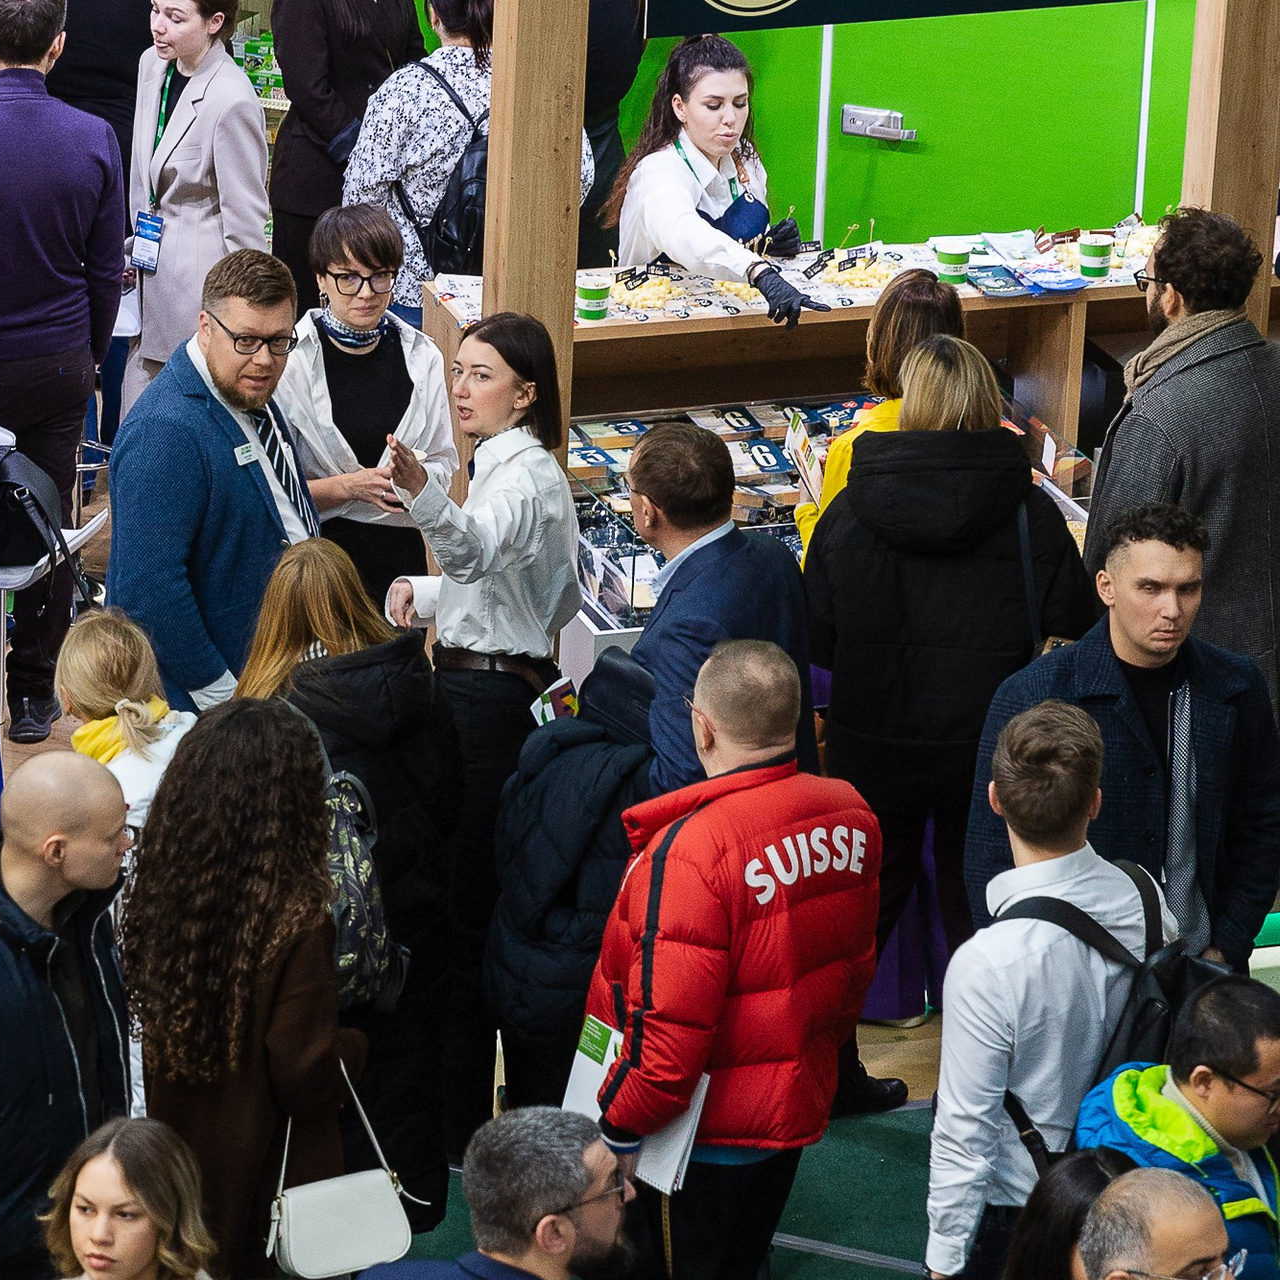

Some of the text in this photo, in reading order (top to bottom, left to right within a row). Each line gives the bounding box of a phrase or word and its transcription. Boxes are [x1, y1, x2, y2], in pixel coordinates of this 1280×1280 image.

[724, 411, 751, 428] 6
[751, 444, 778, 467] 6
[744, 824, 867, 906] SUISSE
